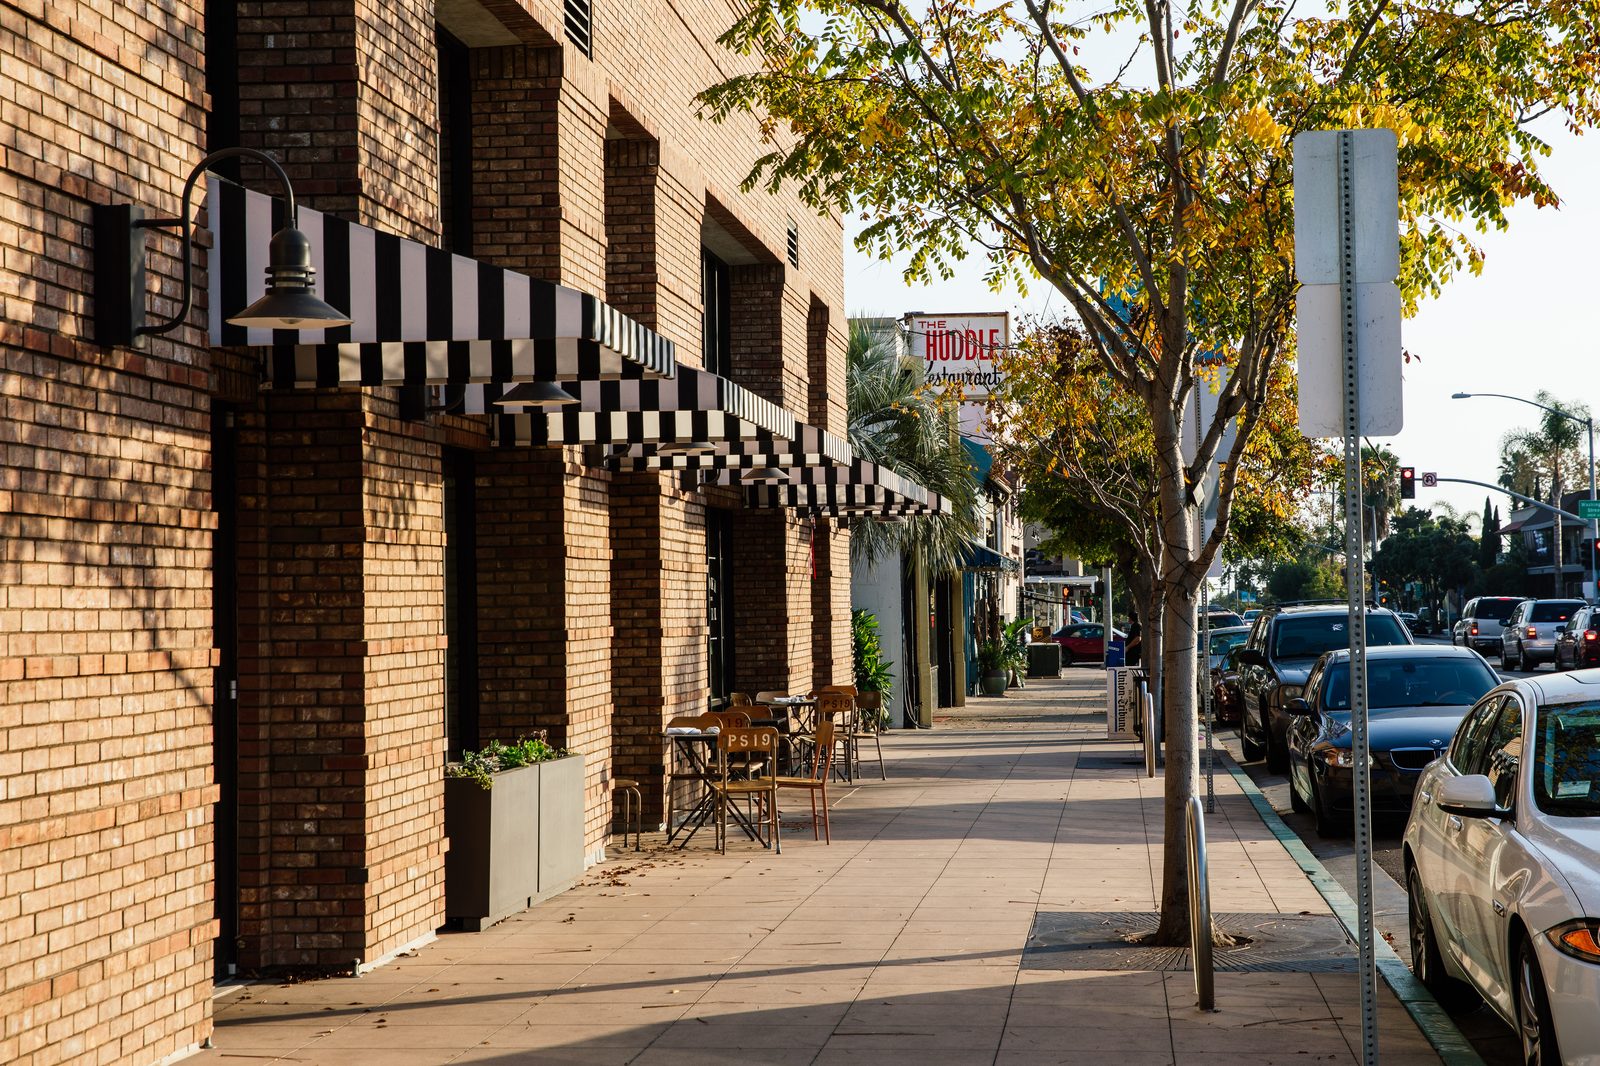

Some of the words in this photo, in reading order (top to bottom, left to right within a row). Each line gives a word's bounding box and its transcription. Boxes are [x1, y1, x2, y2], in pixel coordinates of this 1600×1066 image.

[918, 320, 947, 328] THE
[926, 329, 1000, 361] HUDDLE
[823, 699, 851, 709] PS19
[1117, 670, 1128, 732] Union-Tribune
[727, 717, 743, 728] 19
[728, 733, 771, 748] PS19
